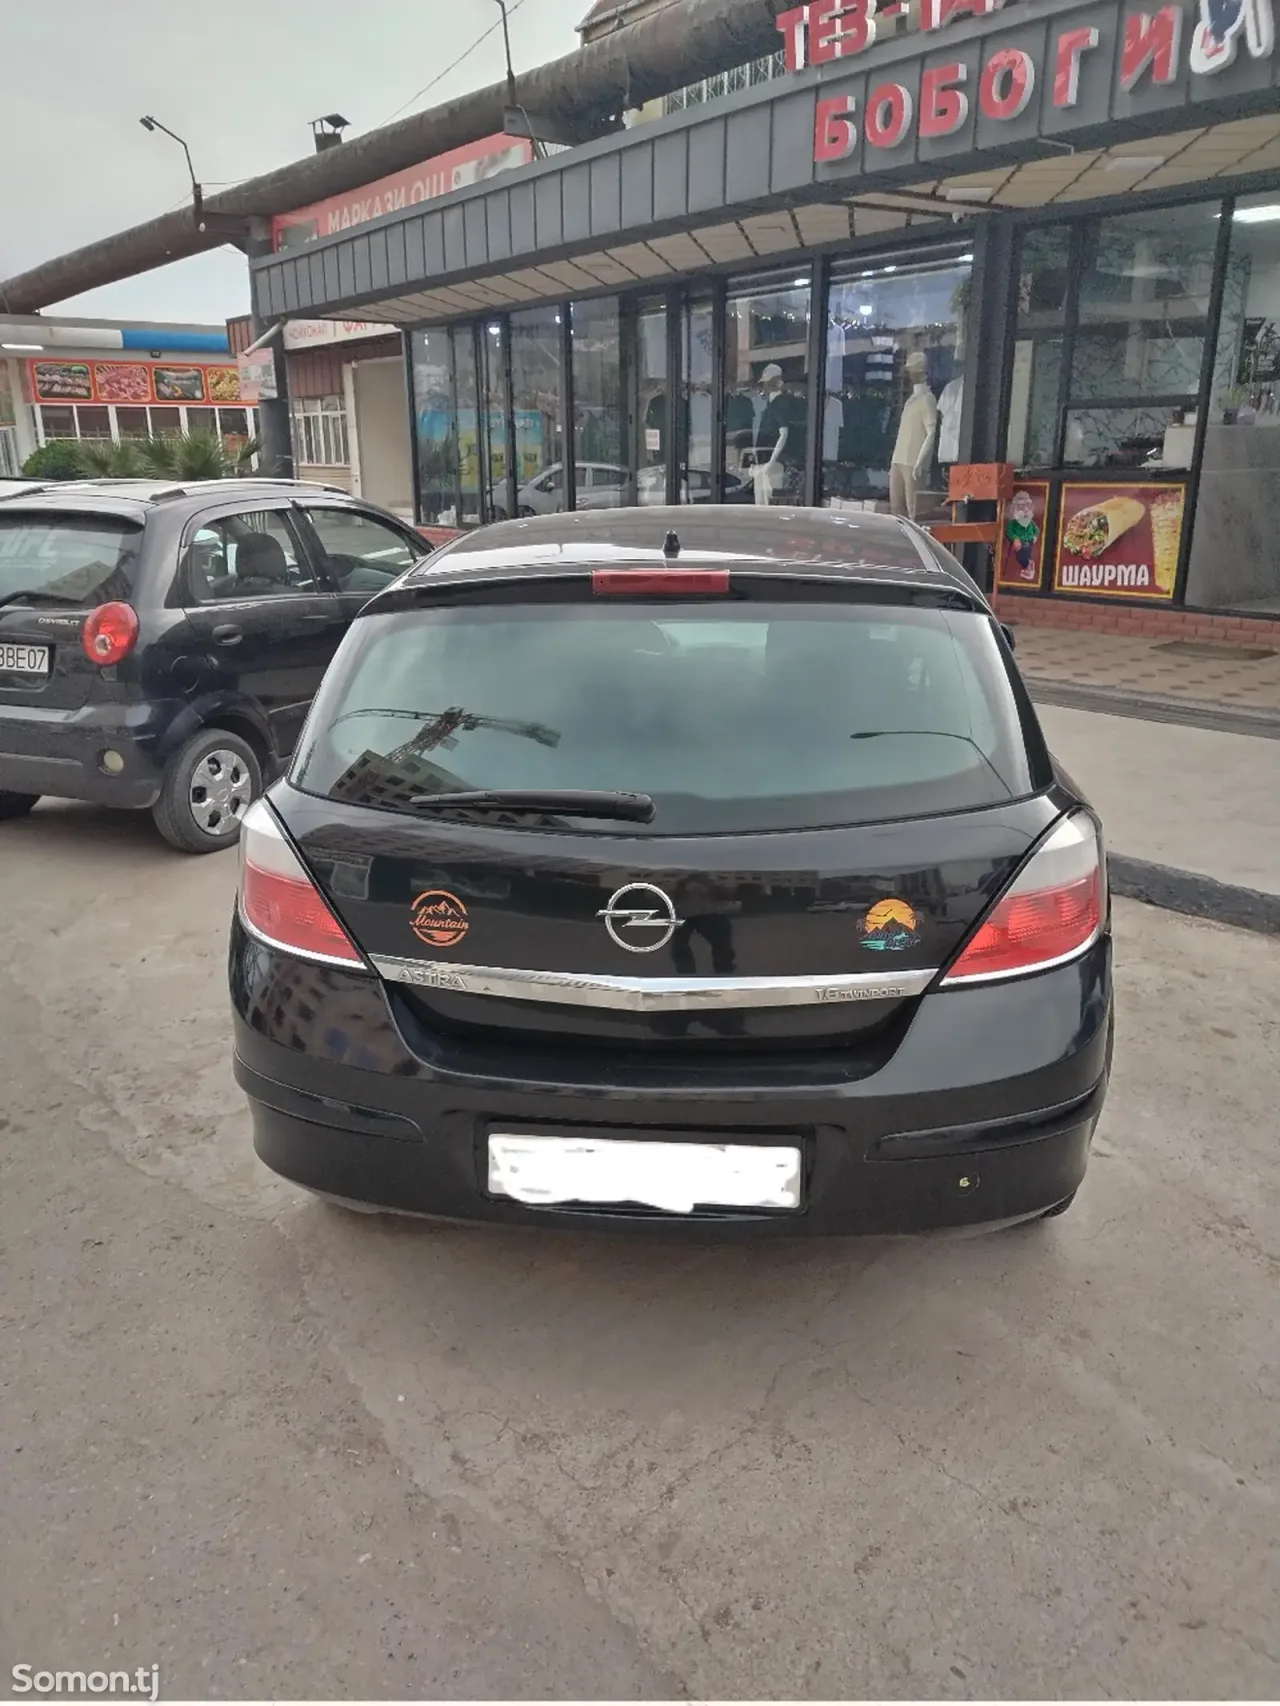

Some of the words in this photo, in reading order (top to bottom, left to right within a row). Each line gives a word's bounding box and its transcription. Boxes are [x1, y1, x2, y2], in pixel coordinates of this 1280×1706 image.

[327, 185, 405, 235] МАРКАЗИ
[1061, 563, 1149, 587] ШАУРМА
[408, 914, 469, 930] Mountain
[397, 967, 467, 990] ASTRA
[840, 986, 906, 1000] TWINPORT
